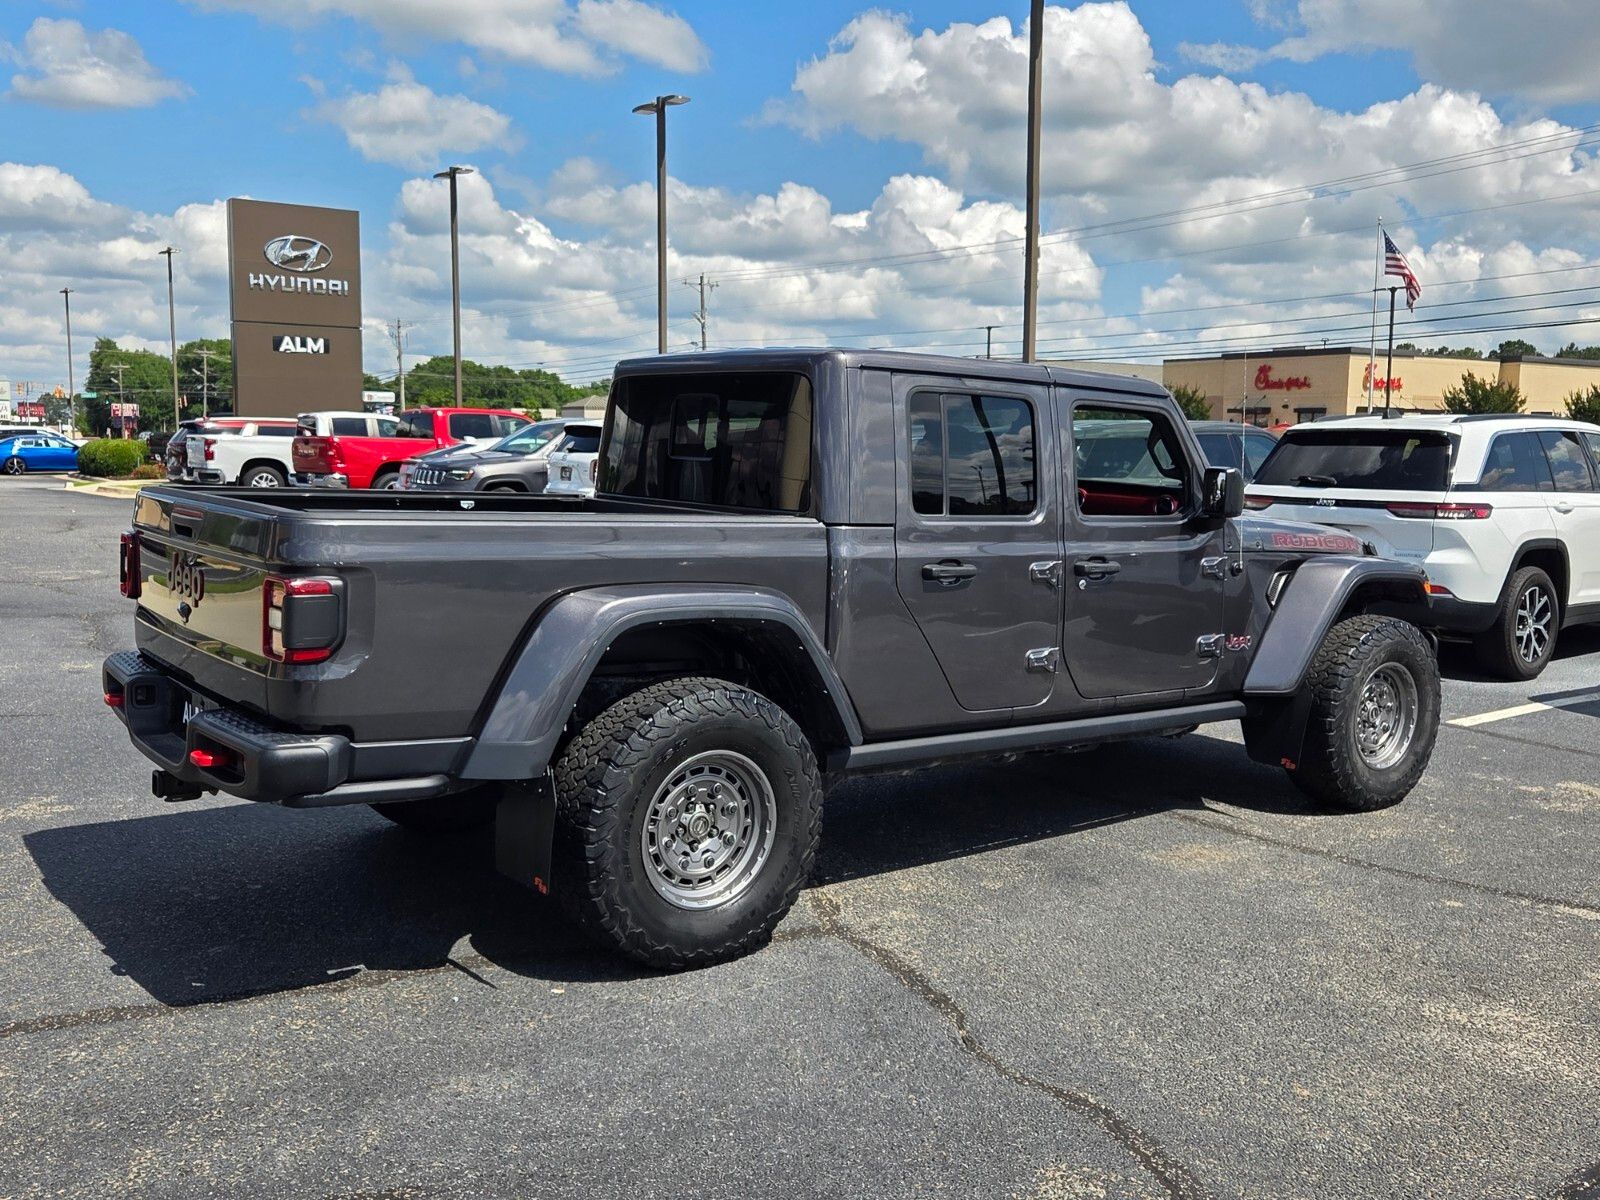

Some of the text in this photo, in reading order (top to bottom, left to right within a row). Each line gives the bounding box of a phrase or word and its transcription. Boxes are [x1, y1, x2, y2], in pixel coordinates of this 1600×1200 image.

[249, 272, 349, 296] HYUNDAI
[279, 336, 325, 354] ALM
[1316, 498, 1336, 506] Jeep
[1273, 533, 1360, 551] RUBICON
[168, 551, 205, 608] Jeep
[1226, 634, 1252, 651] Jeep
